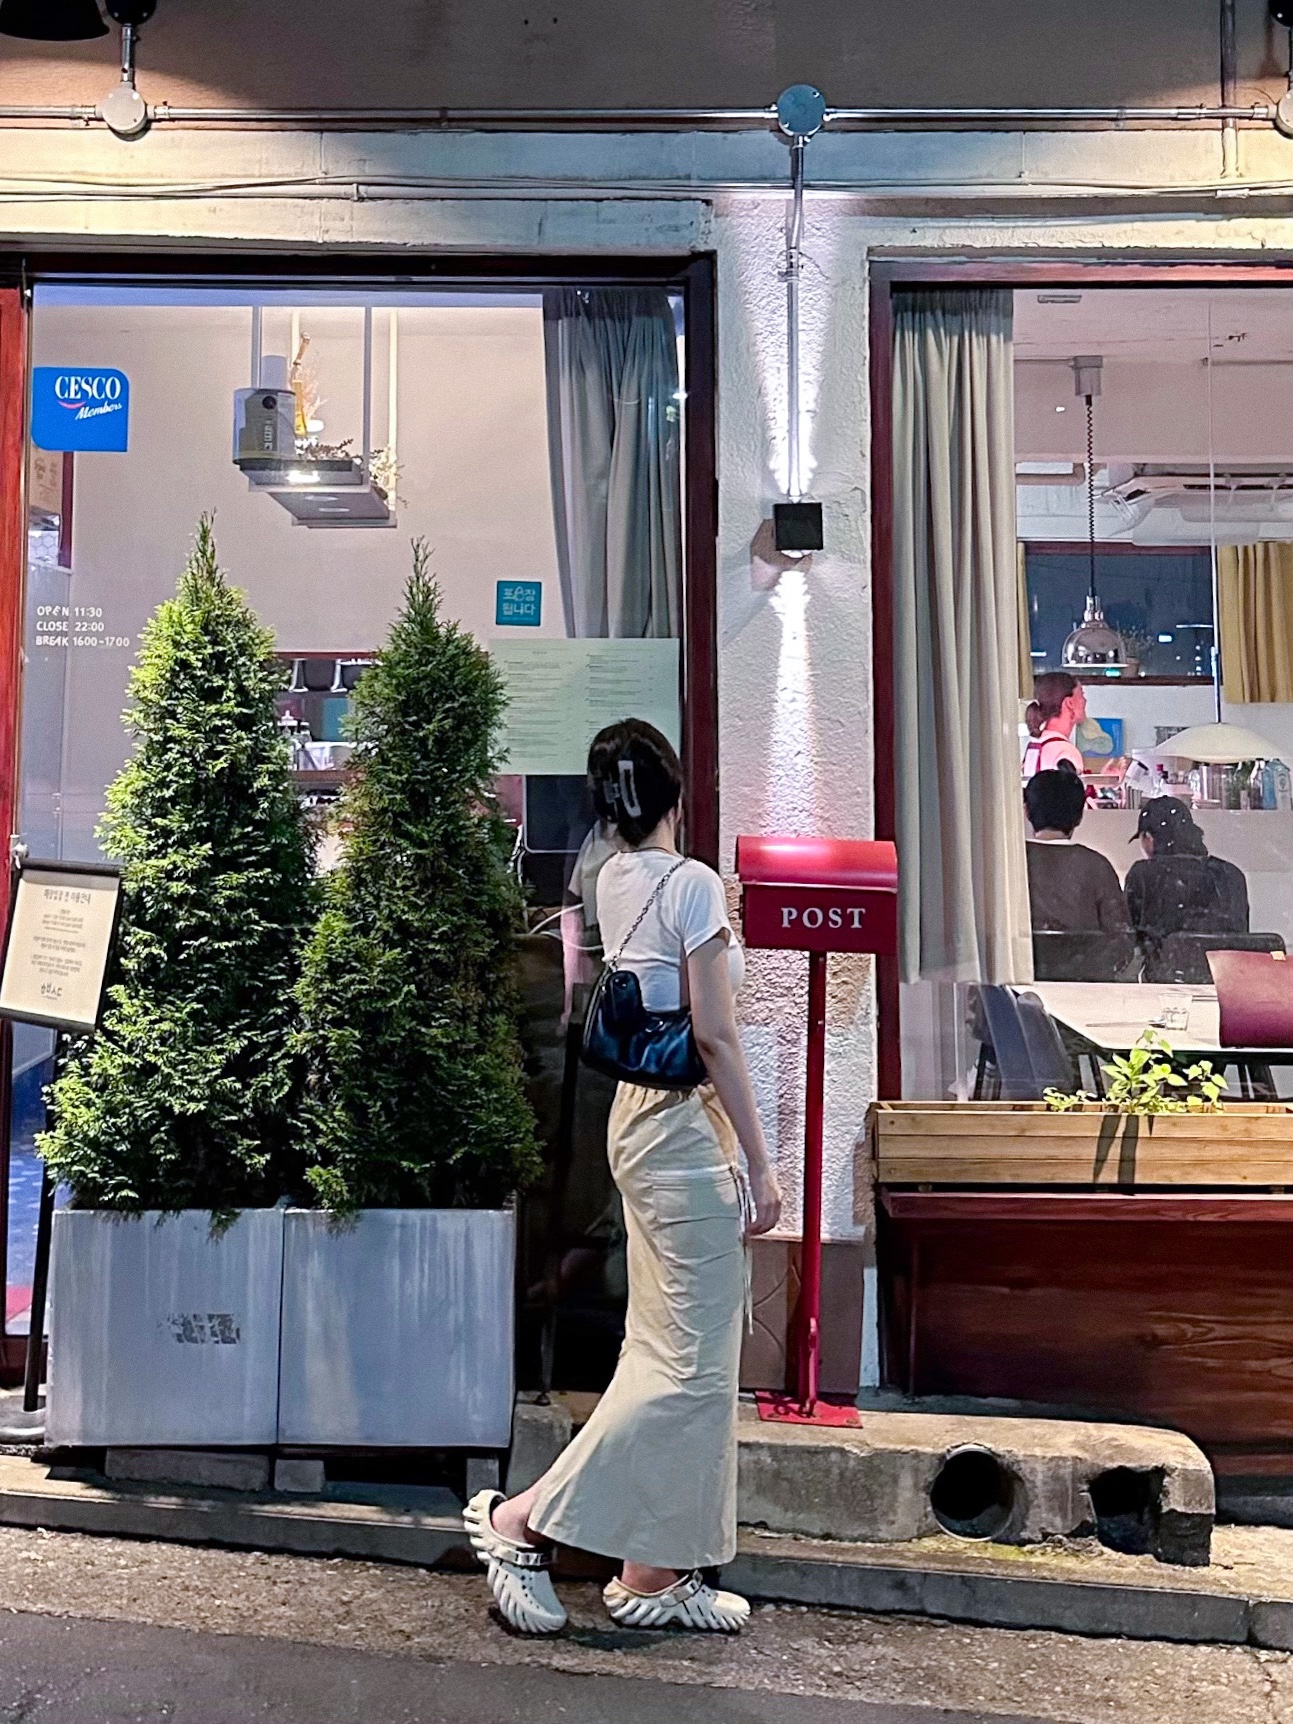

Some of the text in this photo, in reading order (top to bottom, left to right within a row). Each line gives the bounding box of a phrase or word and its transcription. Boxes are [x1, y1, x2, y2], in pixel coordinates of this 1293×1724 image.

[54, 375, 121, 400] CESCO
[74, 401, 122, 420] Members
[36, 605, 103, 618] OPEN 11:30
[502, 602, 536, 616] 됩니다
[36, 621, 105, 632] CLOSE 22:00
[35, 635, 70, 646] BREAK
[780, 907, 866, 929] POST
